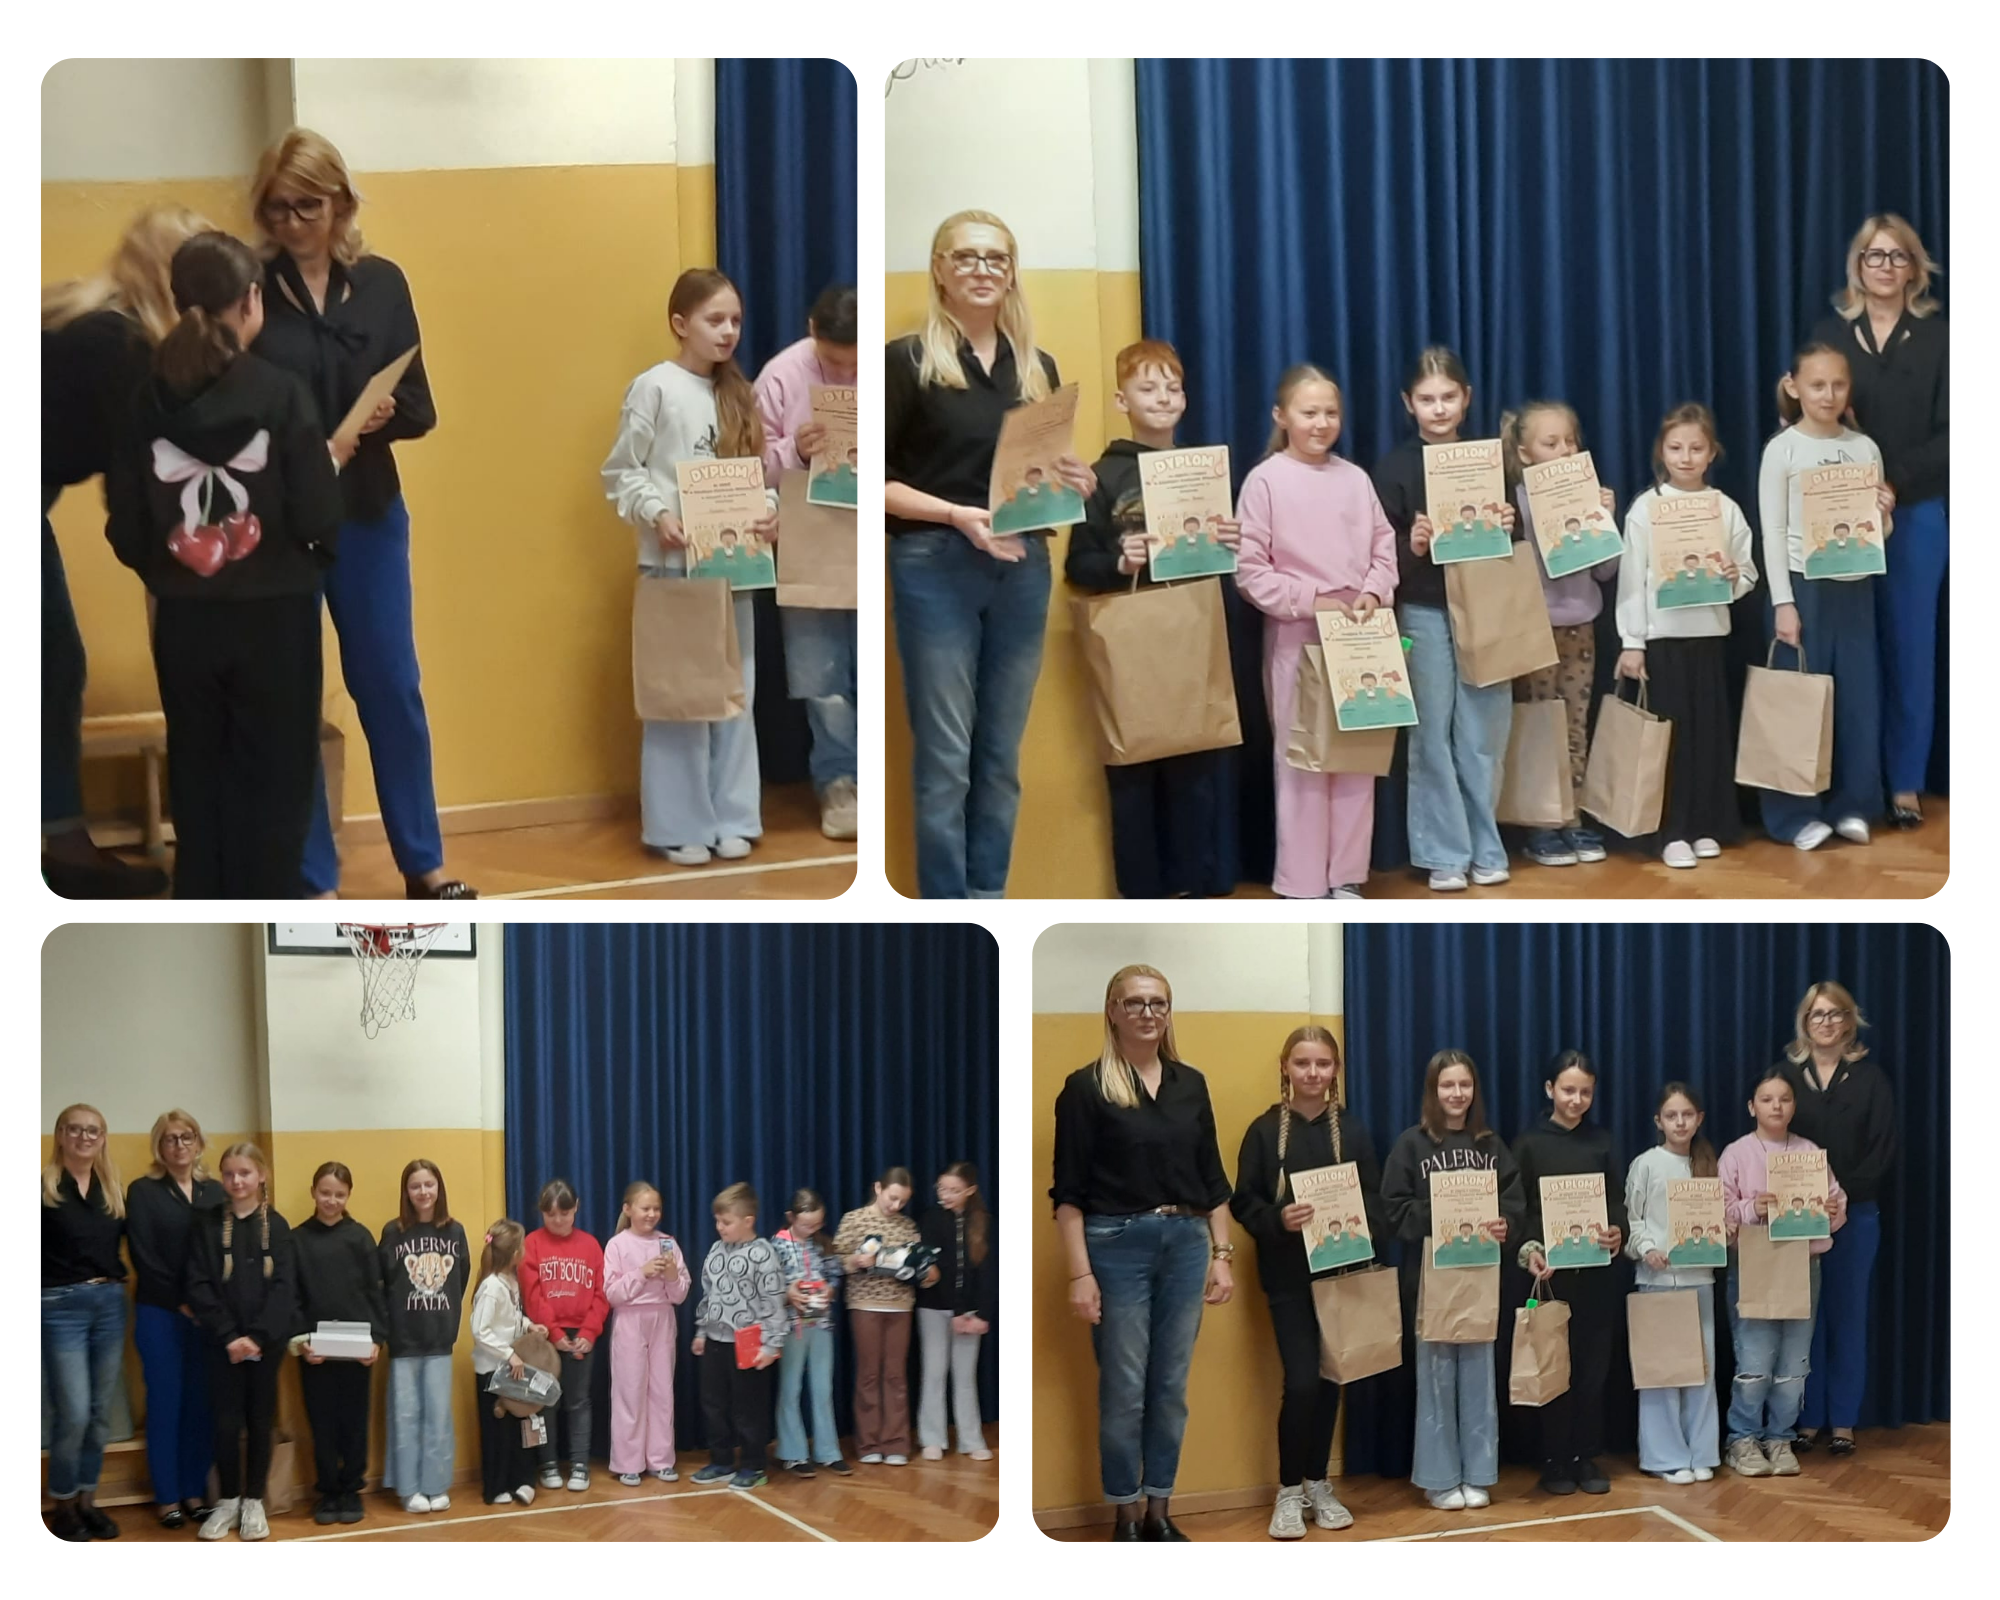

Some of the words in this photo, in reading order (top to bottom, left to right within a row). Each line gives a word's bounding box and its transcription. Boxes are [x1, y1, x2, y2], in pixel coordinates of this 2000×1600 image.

[822, 388, 857, 402] DYP
[1154, 453, 1214, 474] DYPLOM
[1436, 446, 1489, 465] DYPLOM
[690, 463, 748, 483] DYPLOM
[1534, 461, 1582, 484] DYPLOM
[1812, 468, 1864, 485] DYPLOM
[1659, 497, 1710, 514] DYPLOM
[1775, 1153, 1817, 1166] DYPLOM
[1303, 1170, 1348, 1188] DYPLOM
[1441, 1174, 1487, 1189] DYPLOM
[1550, 1179, 1595, 1193] DYPLOM
[406, 1295, 450, 1311] ITALIA
